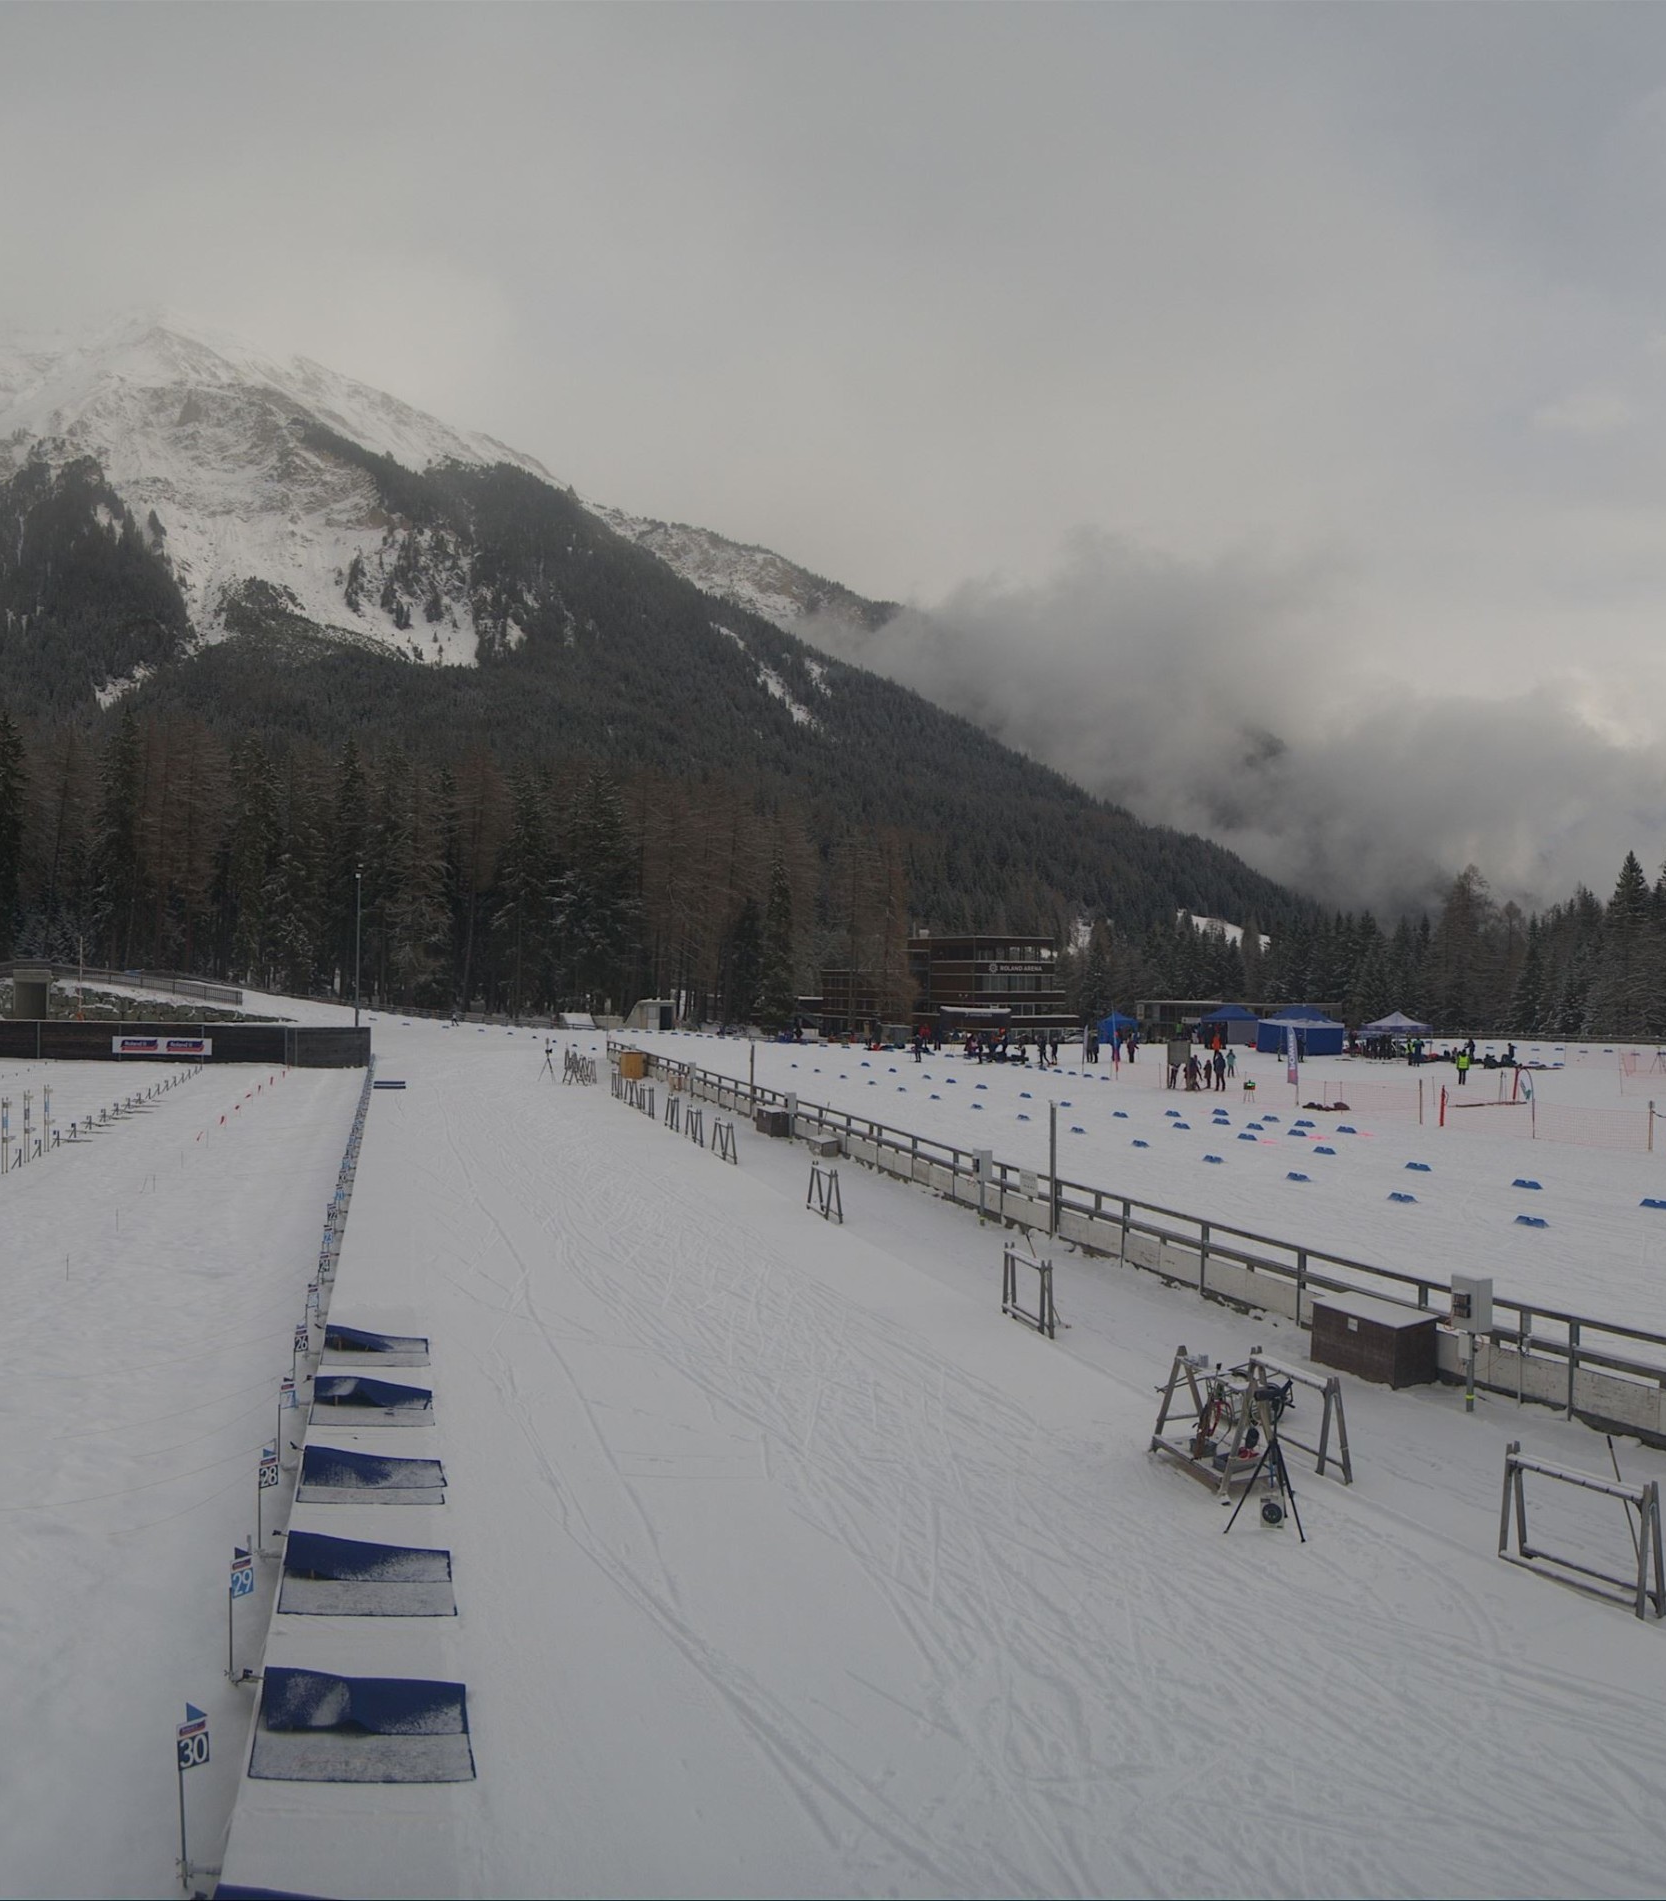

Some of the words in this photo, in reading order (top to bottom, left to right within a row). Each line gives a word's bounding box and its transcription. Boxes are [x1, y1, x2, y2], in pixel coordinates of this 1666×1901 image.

[295, 1335, 308, 1351] 26
[260, 1466, 277, 1488] 28
[232, 1569, 253, 1597] 29
[179, 1733, 208, 1768] 30
